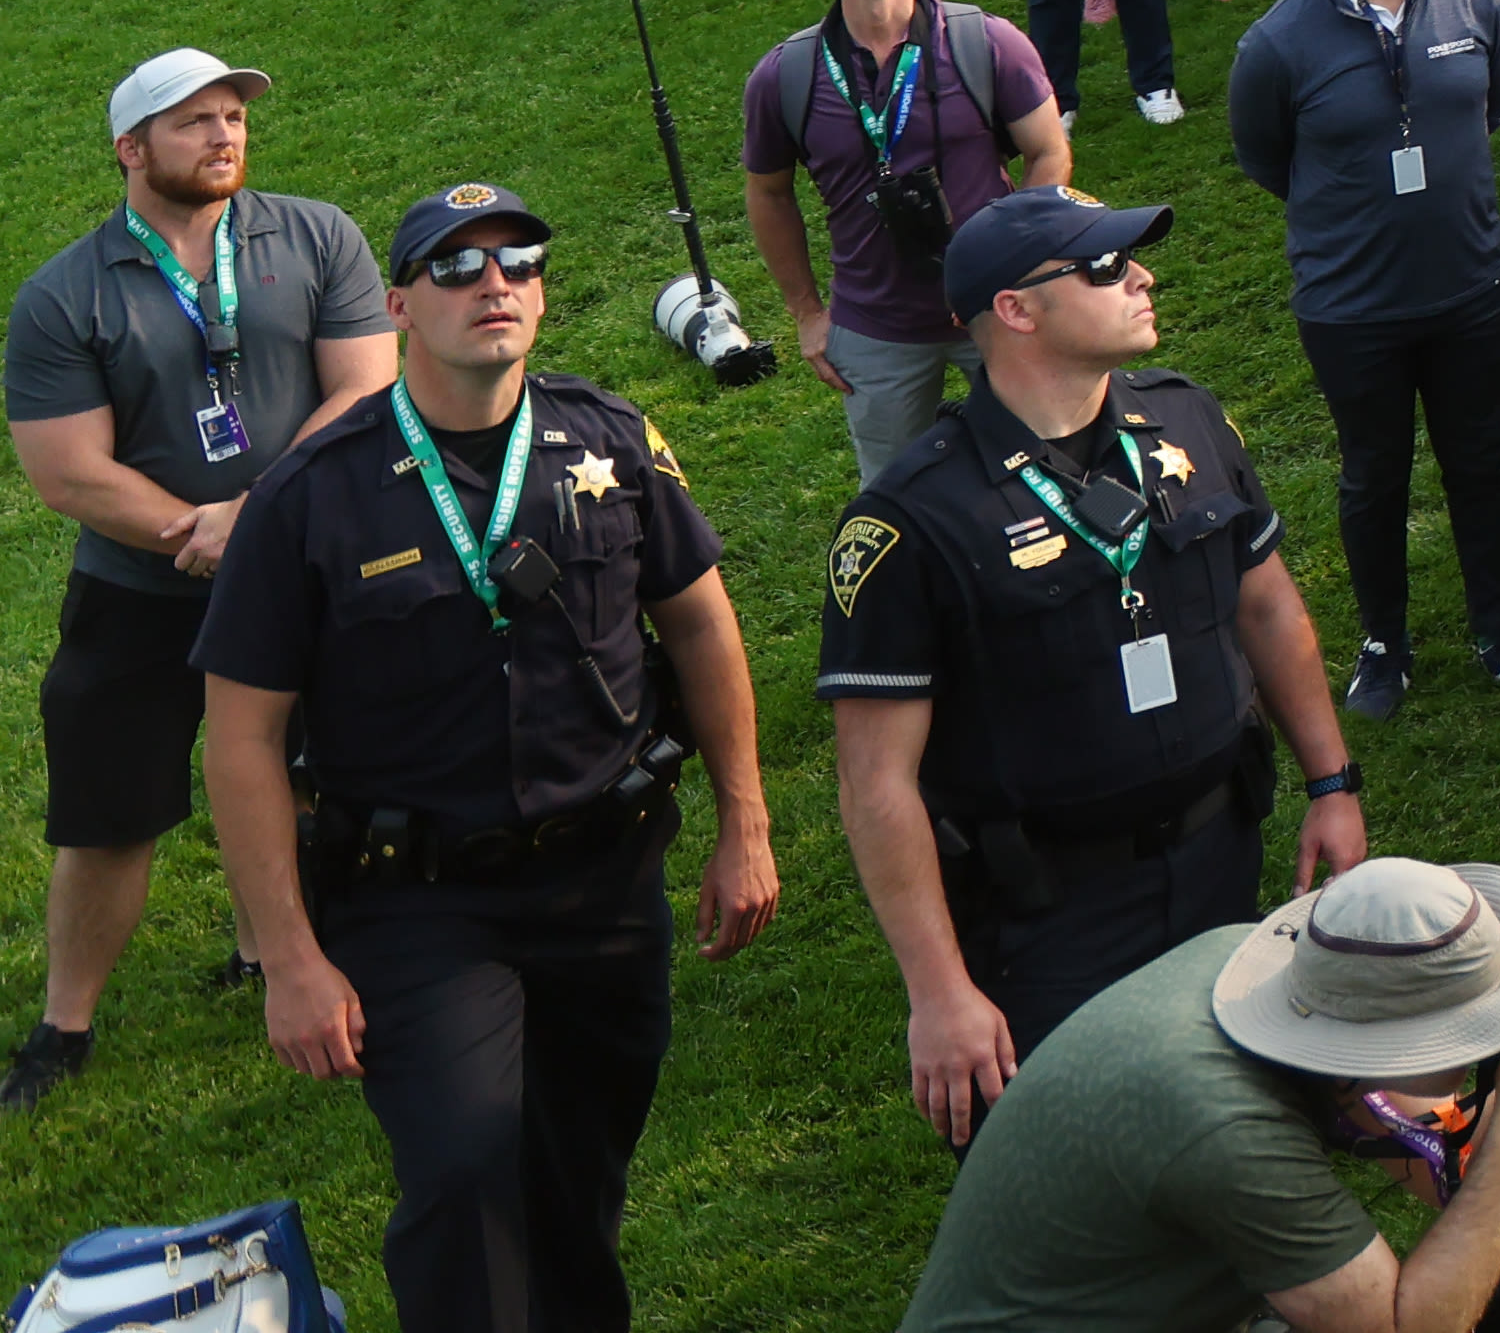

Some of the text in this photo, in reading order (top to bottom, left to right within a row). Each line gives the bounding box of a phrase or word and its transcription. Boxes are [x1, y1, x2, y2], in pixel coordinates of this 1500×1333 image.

[433, 482, 474, 554] SECURITY
[489, 434, 528, 541] INSIDE ROPES
[1037, 476, 1081, 529] INSIDE
